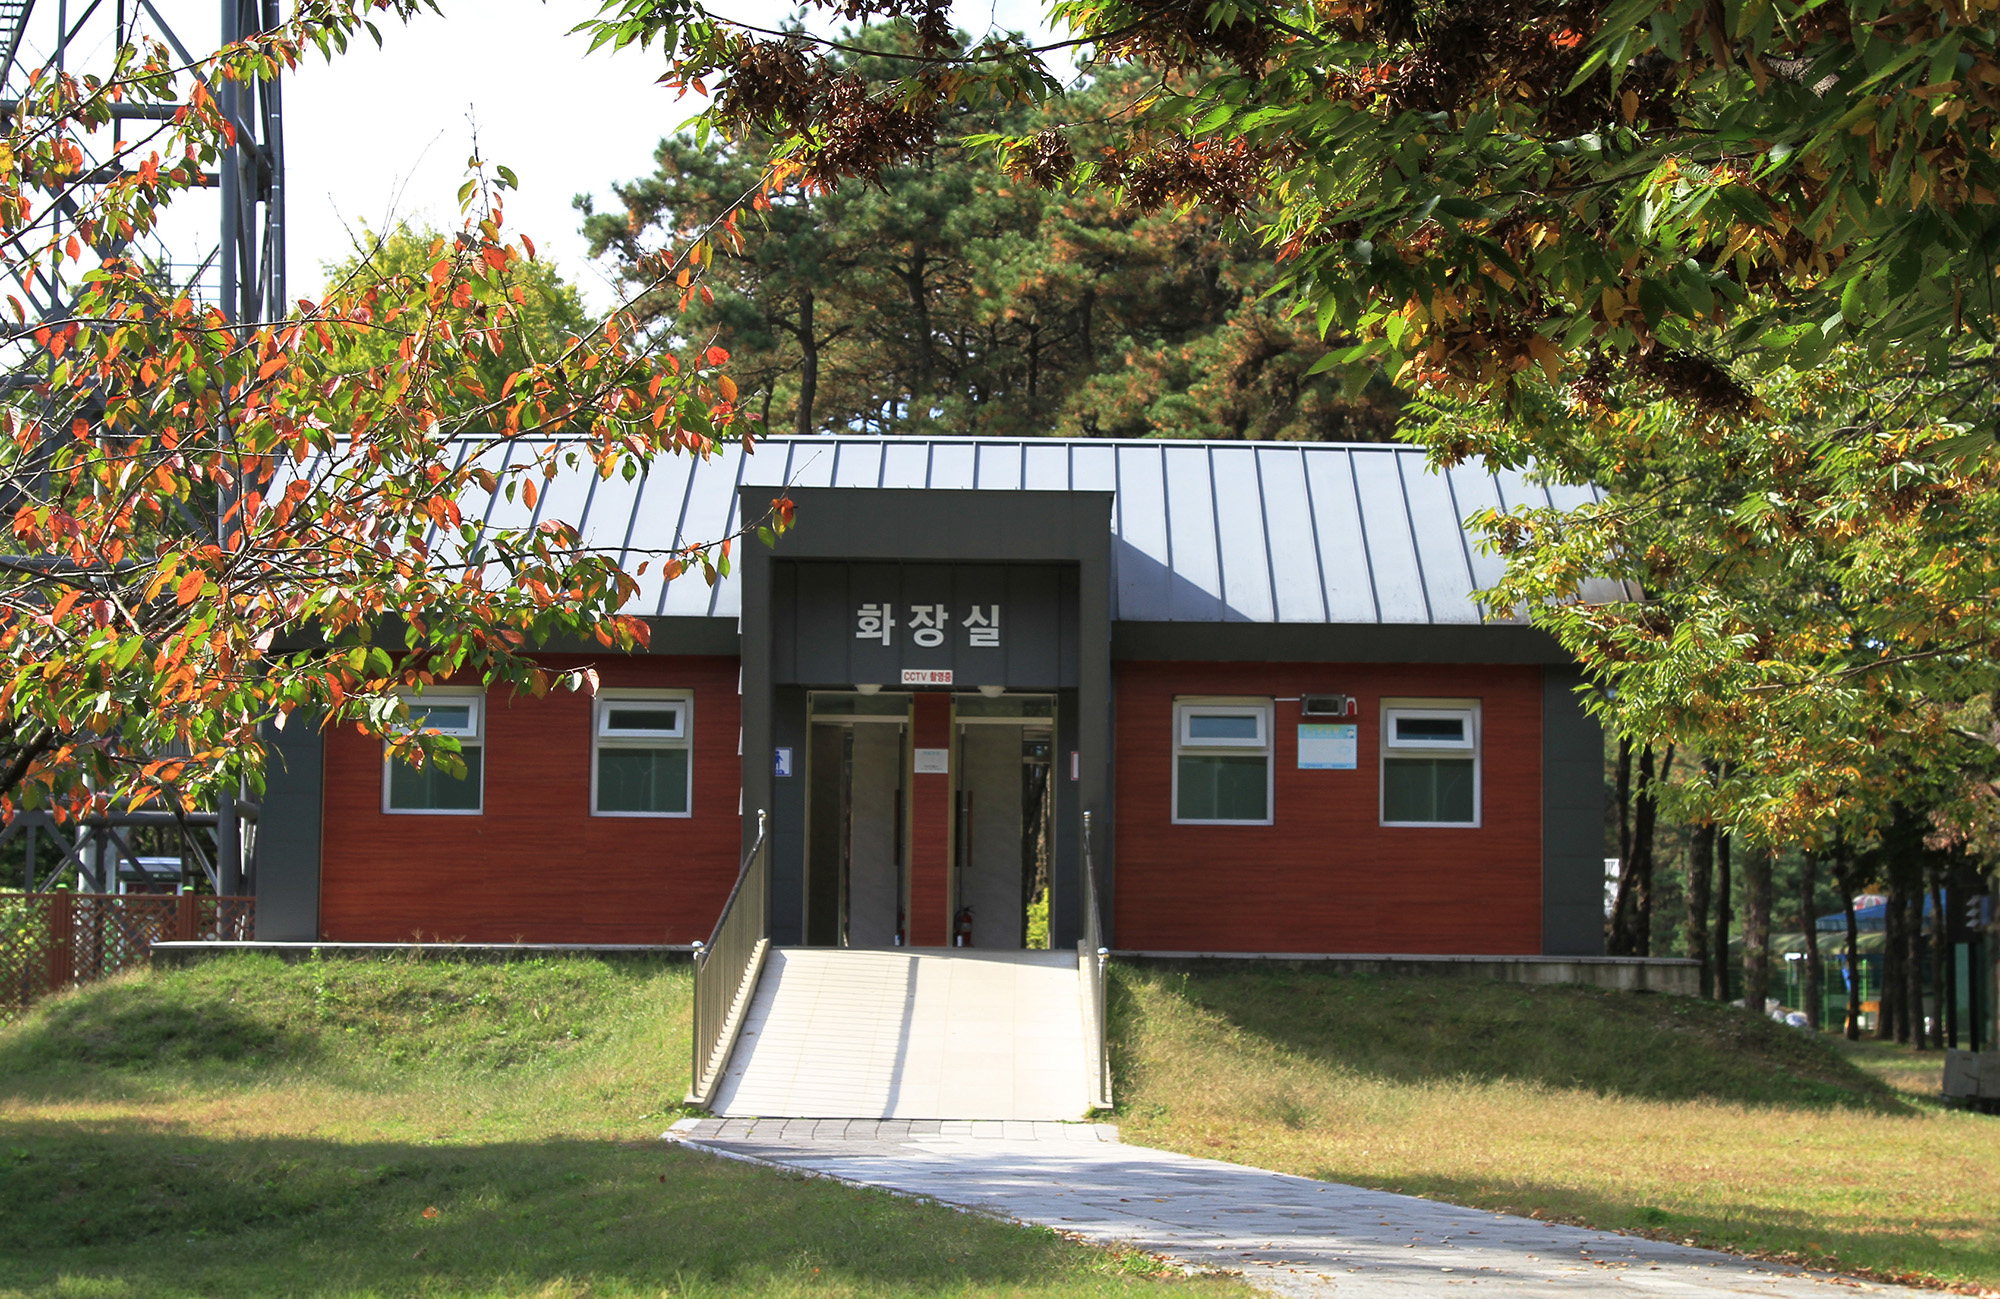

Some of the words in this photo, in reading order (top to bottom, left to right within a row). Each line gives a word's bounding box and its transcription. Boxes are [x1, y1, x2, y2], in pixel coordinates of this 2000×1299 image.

[856, 603, 1000, 647] 화장실
[903, 671, 928, 681] CCTV
[930, 671, 952, 682] 촬영중
